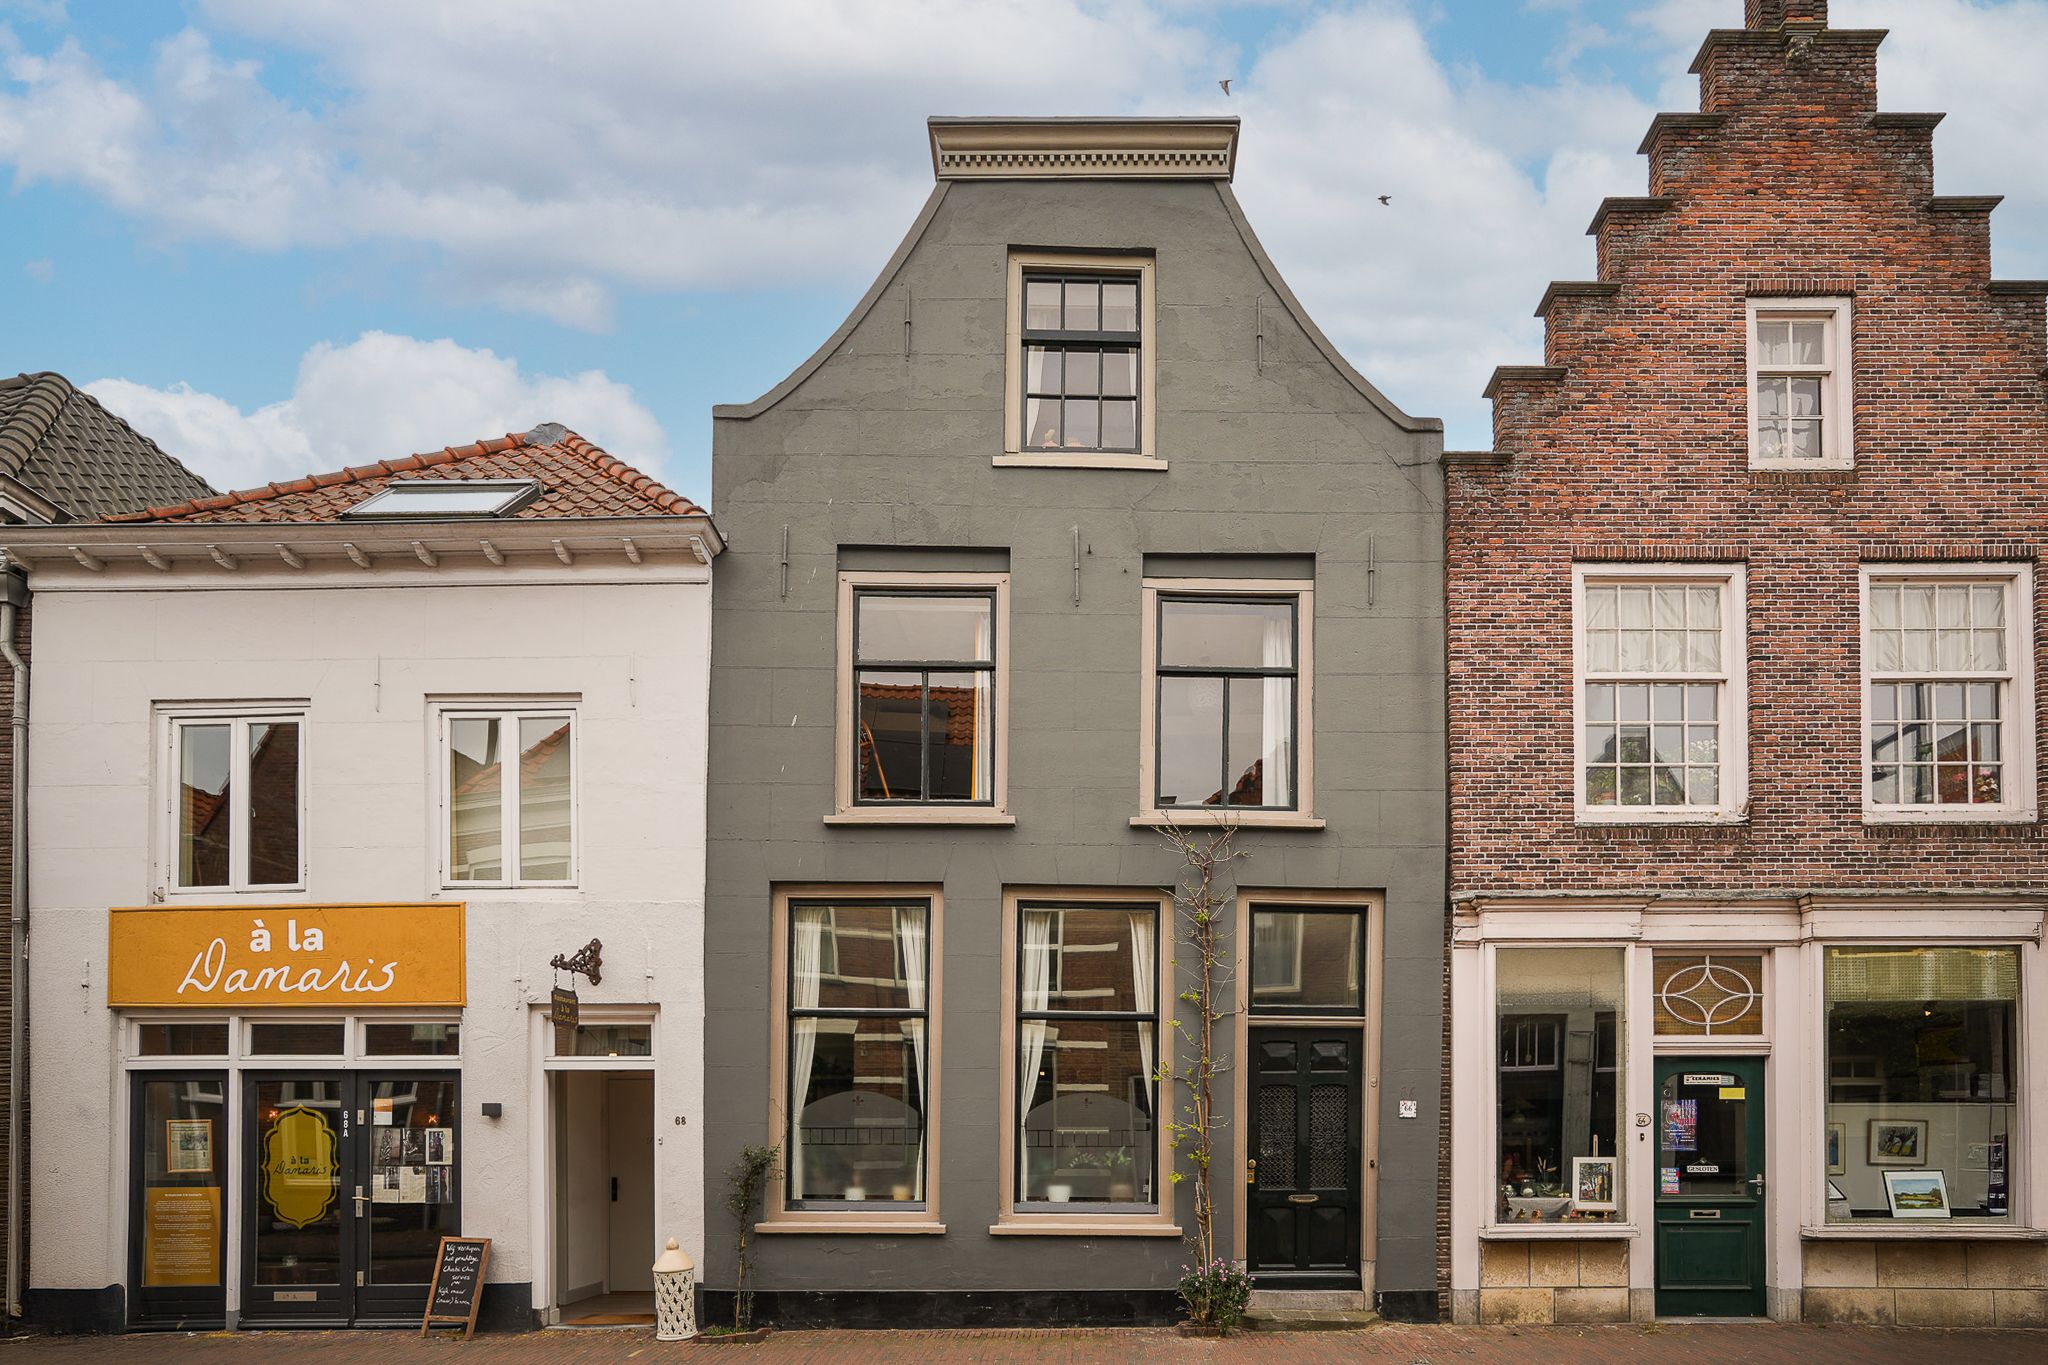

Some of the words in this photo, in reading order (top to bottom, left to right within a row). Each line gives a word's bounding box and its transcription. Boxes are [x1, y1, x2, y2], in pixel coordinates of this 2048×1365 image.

[249, 918, 272, 953] à
[287, 918, 324, 952] la
[175, 936, 398, 994] Damaris
[674, 1115, 686, 1126] 68
[1637, 1116, 1646, 1125] 64
[290, 1155, 297, 1165] à
[299, 1155, 310, 1165] la
[272, 1160, 328, 1176] Damaris
